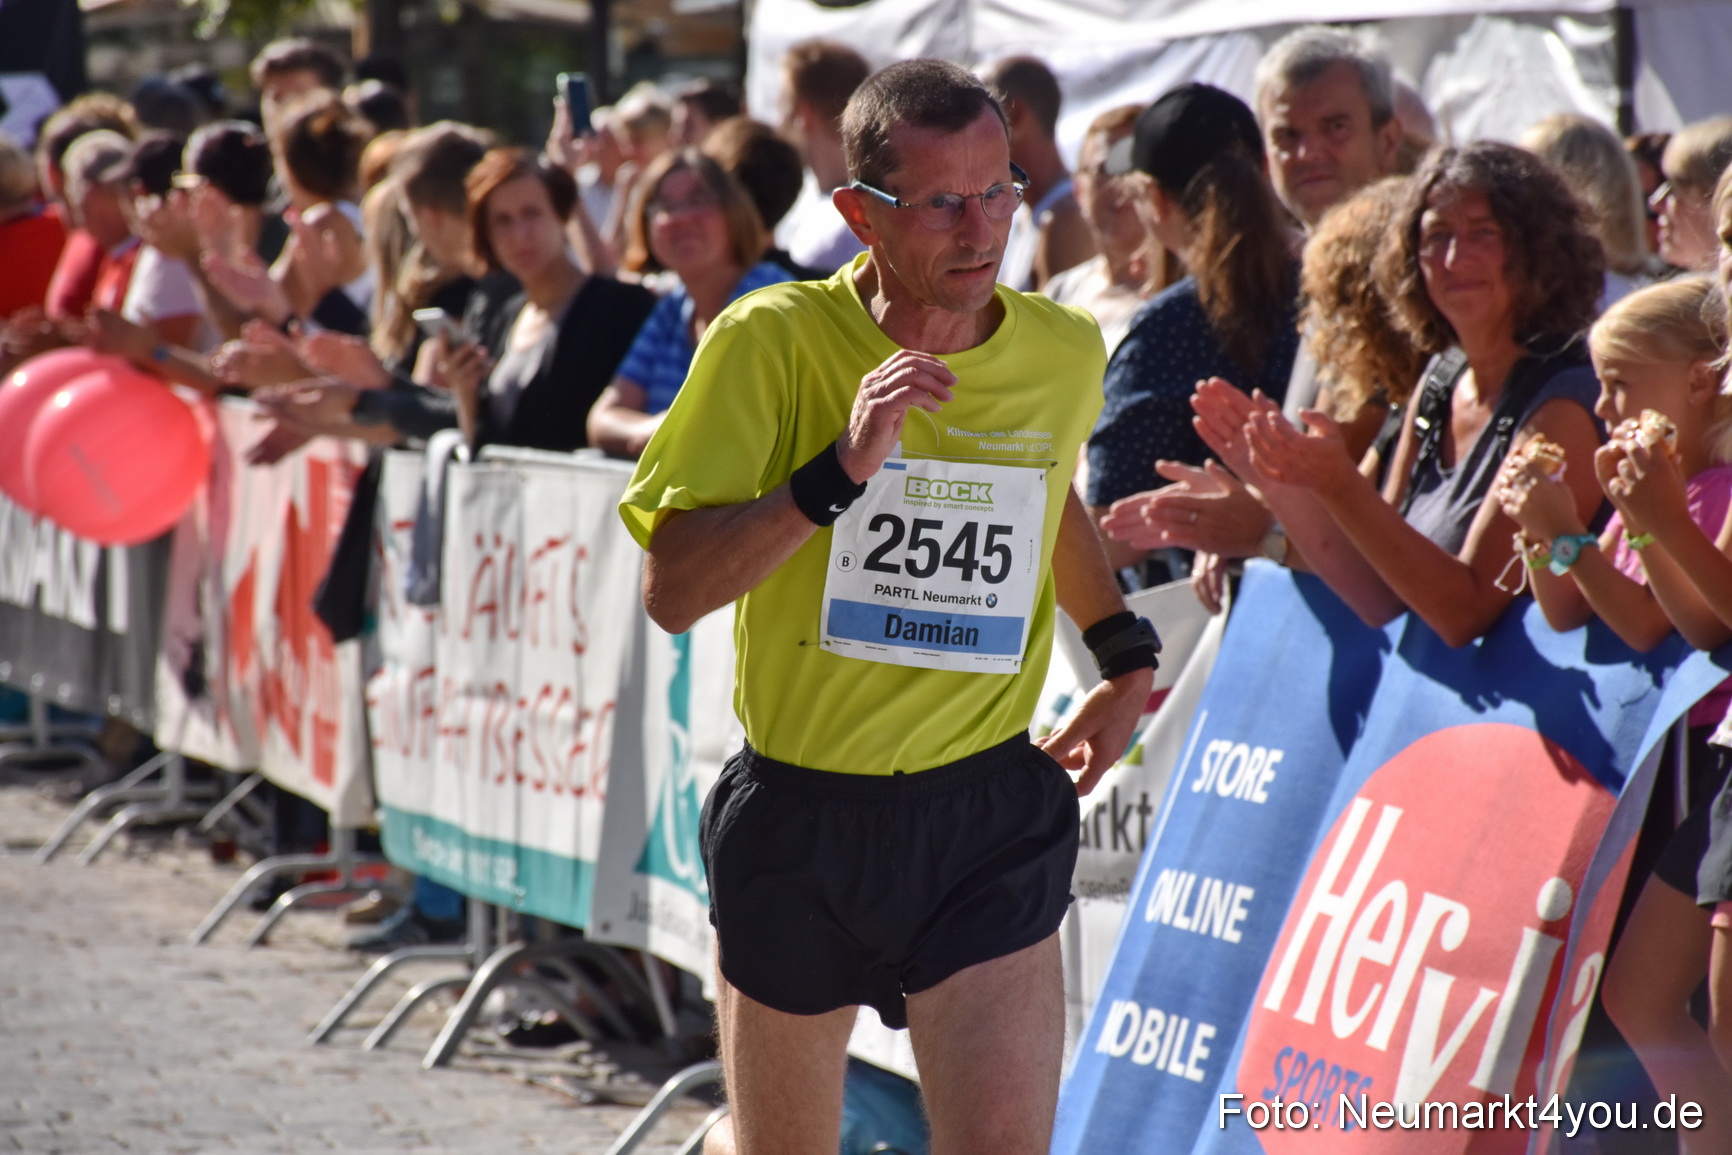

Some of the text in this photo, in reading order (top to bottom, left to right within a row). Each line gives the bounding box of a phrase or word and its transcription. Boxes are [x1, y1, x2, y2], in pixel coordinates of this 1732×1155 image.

[978, 441, 1024, 453] Neumarkt
[1008, 428, 1053, 440] Landkreises
[905, 476, 994, 504] BOCK
[903, 498, 932, 507] inspired
[933, 501, 941, 509] by
[964, 504, 995, 513] concepts
[841, 556, 850, 567] B
[863, 513, 1014, 584] 2545
[874, 584, 982, 606] PARTL Neumarkt
[884, 613, 980, 647] Damian
[1191, 738, 1284, 804] STORE
[1144, 867, 1255, 944] ONLINE
[1261, 1045, 1373, 1133] SPORTS
